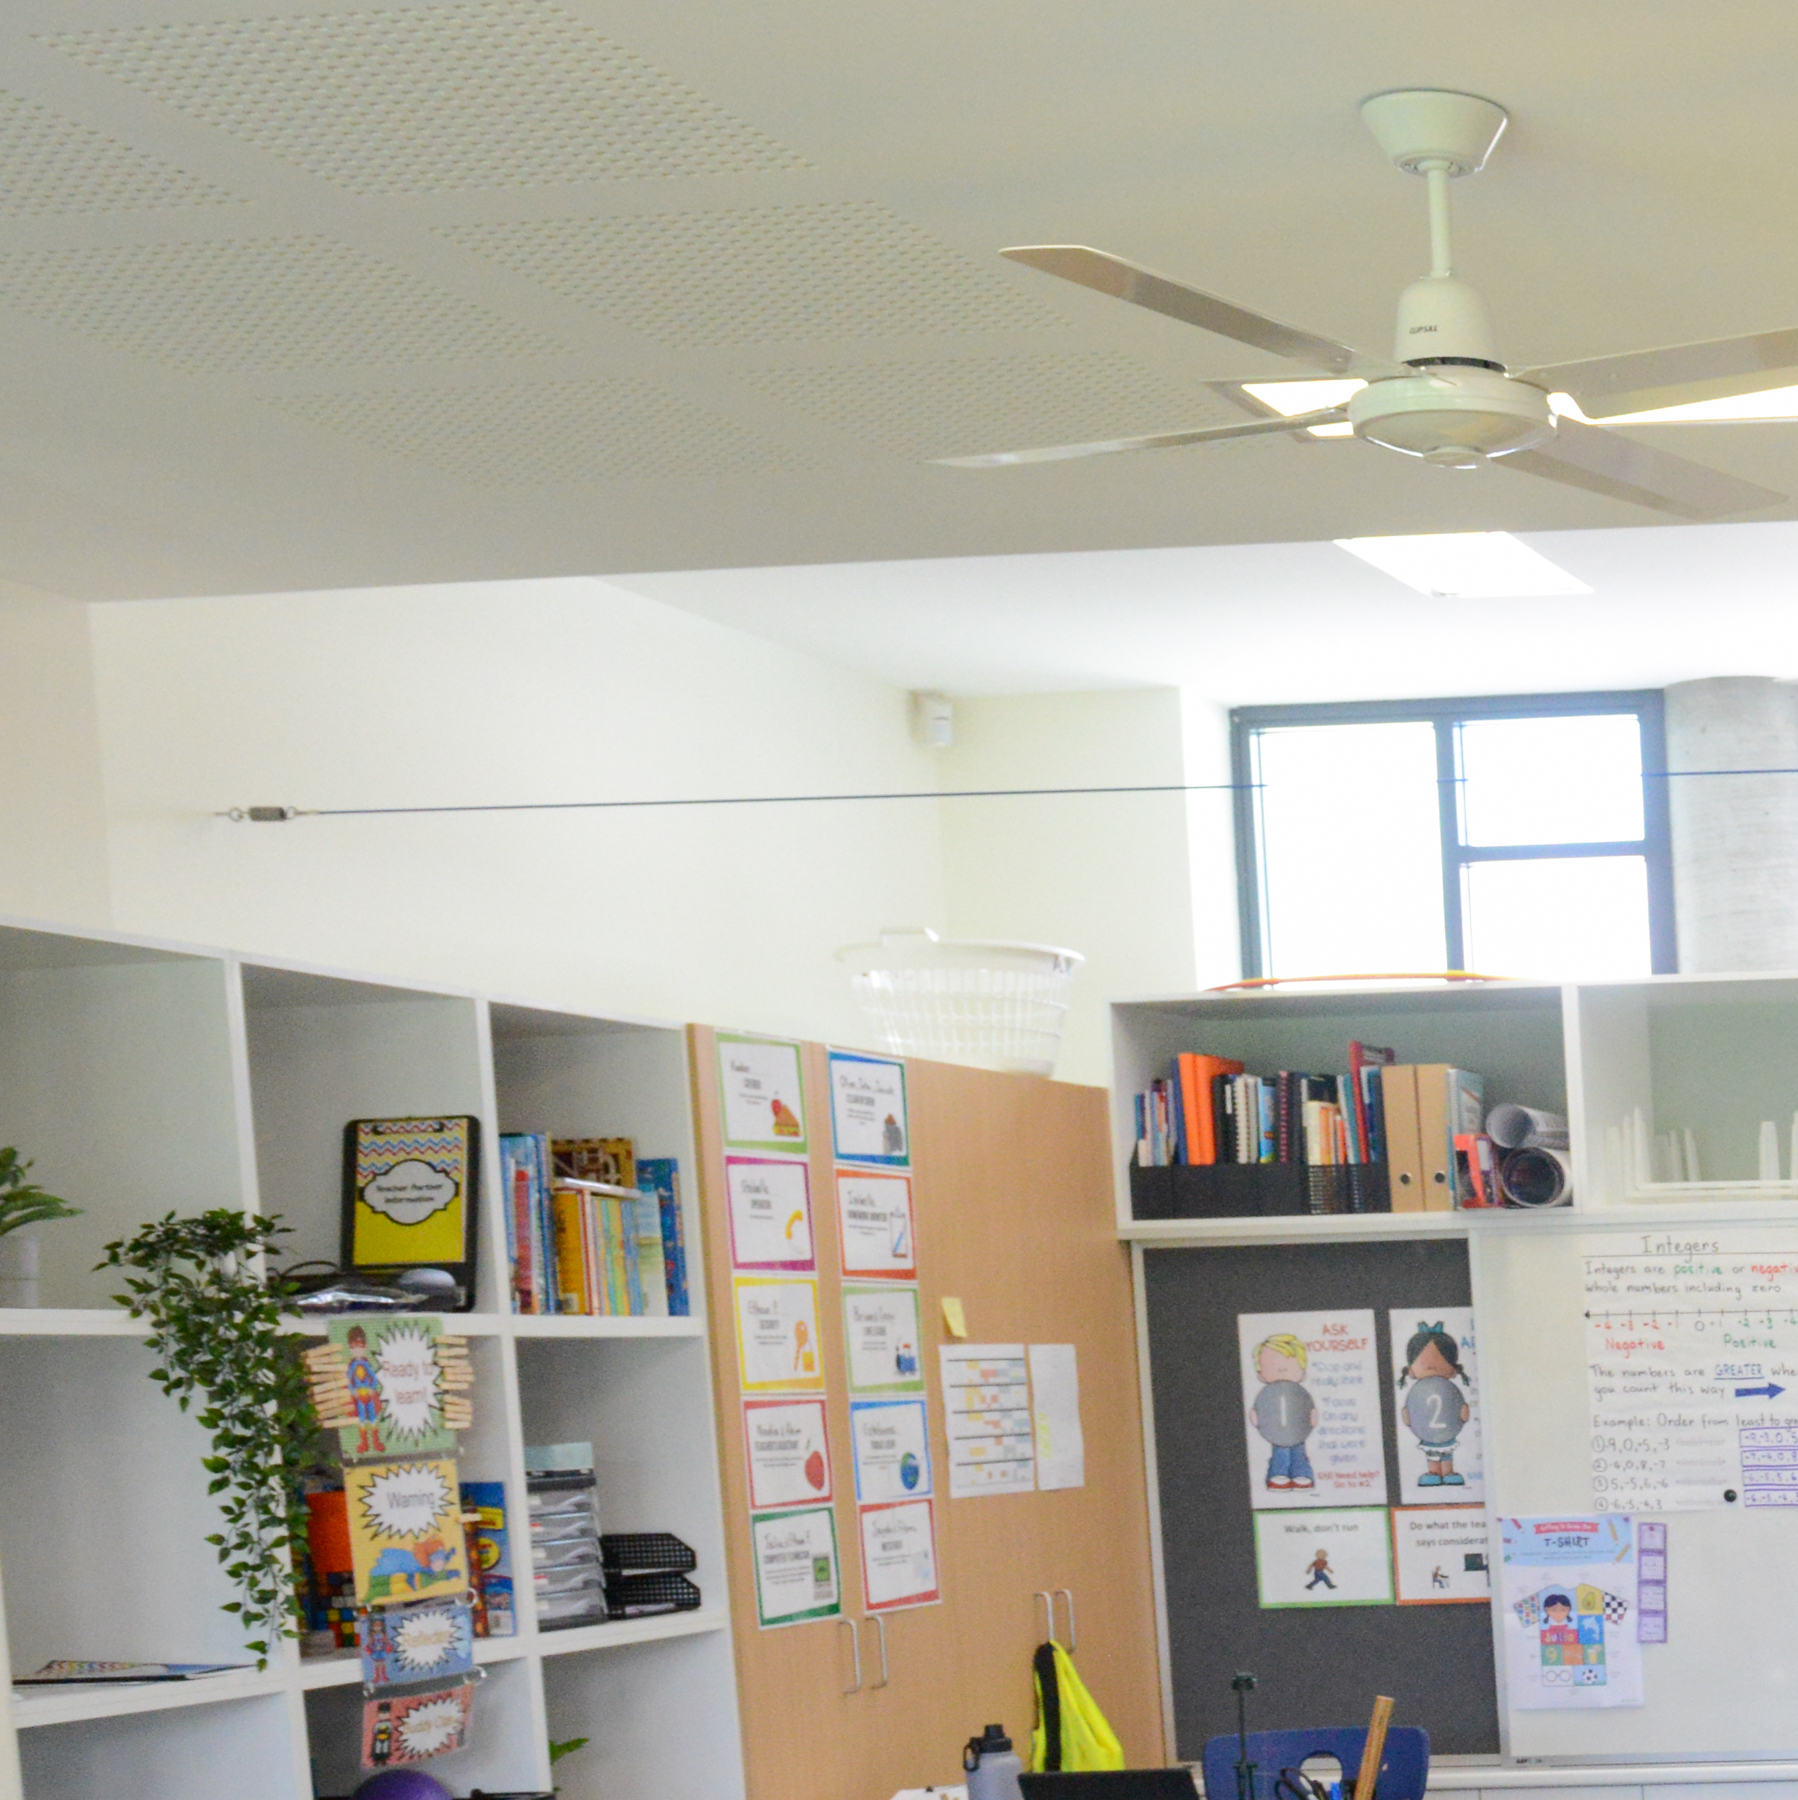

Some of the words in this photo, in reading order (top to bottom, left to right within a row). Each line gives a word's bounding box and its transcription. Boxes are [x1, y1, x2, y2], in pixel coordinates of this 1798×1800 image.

[1640, 1234, 1720, 1263] Integers
[1584, 1260, 1636, 1280] Integers
[1643, 1265, 1666, 1275] are
[1673, 1262, 1724, 1279] positive
[1732, 1265, 1746, 1275] or
[1585, 1281, 1619, 1294] whole
[1626, 1280, 1679, 1294] numbers
[1684, 1280, 1743, 1300] including
[1321, 1323, 1349, 1335] ASK
[1694, 1320, 1706, 1332] 0
[1305, 1337, 1370, 1351] YOURSELF
[1604, 1337, 1666, 1359] Negative
[1722, 1332, 1778, 1349] Positive
[382, 1361, 419, 1381] Ready
[422, 1363, 434, 1377] to
[1589, 1364, 1615, 1378] The
[1621, 1367, 1676, 1378] numbers
[1684, 1367, 1706, 1377] are
[1714, 1363, 1764, 1377] GREATER
[394, 1388, 427, 1404] learn!
[1593, 1384, 1615, 1403] you
[1622, 1383, 1659, 1394] count
[1668, 1382, 1695, 1395] this
[1700, 1385, 1726, 1398] way
[1426, 1394, 1447, 1429] 2
[1592, 1413, 1651, 1432] Example:
[1656, 1412, 1695, 1428] Order
[1701, 1412, 1730, 1427] from
[1735, 1412, 1766, 1427] least
[1769, 1413, 1781, 1427] to
[1317, 1425, 1367, 1436] directions
[1329, 1452, 1358, 1465] given
[386, 1491, 435, 1509] Warning
[1284, 1524, 1310, 1534] Walk,
[1313, 1522, 1340, 1533] don't
[1341, 1523, 1359, 1532] run
[1409, 1521, 1423, 1531] Do
[1425, 1520, 1450, 1531] what
[1451, 1519, 1469, 1530] the
[1416, 1538, 1436, 1549] says
[1543, 1536, 1591, 1548] T-SHIRT
[1545, 1632, 1575, 1643] Julia
